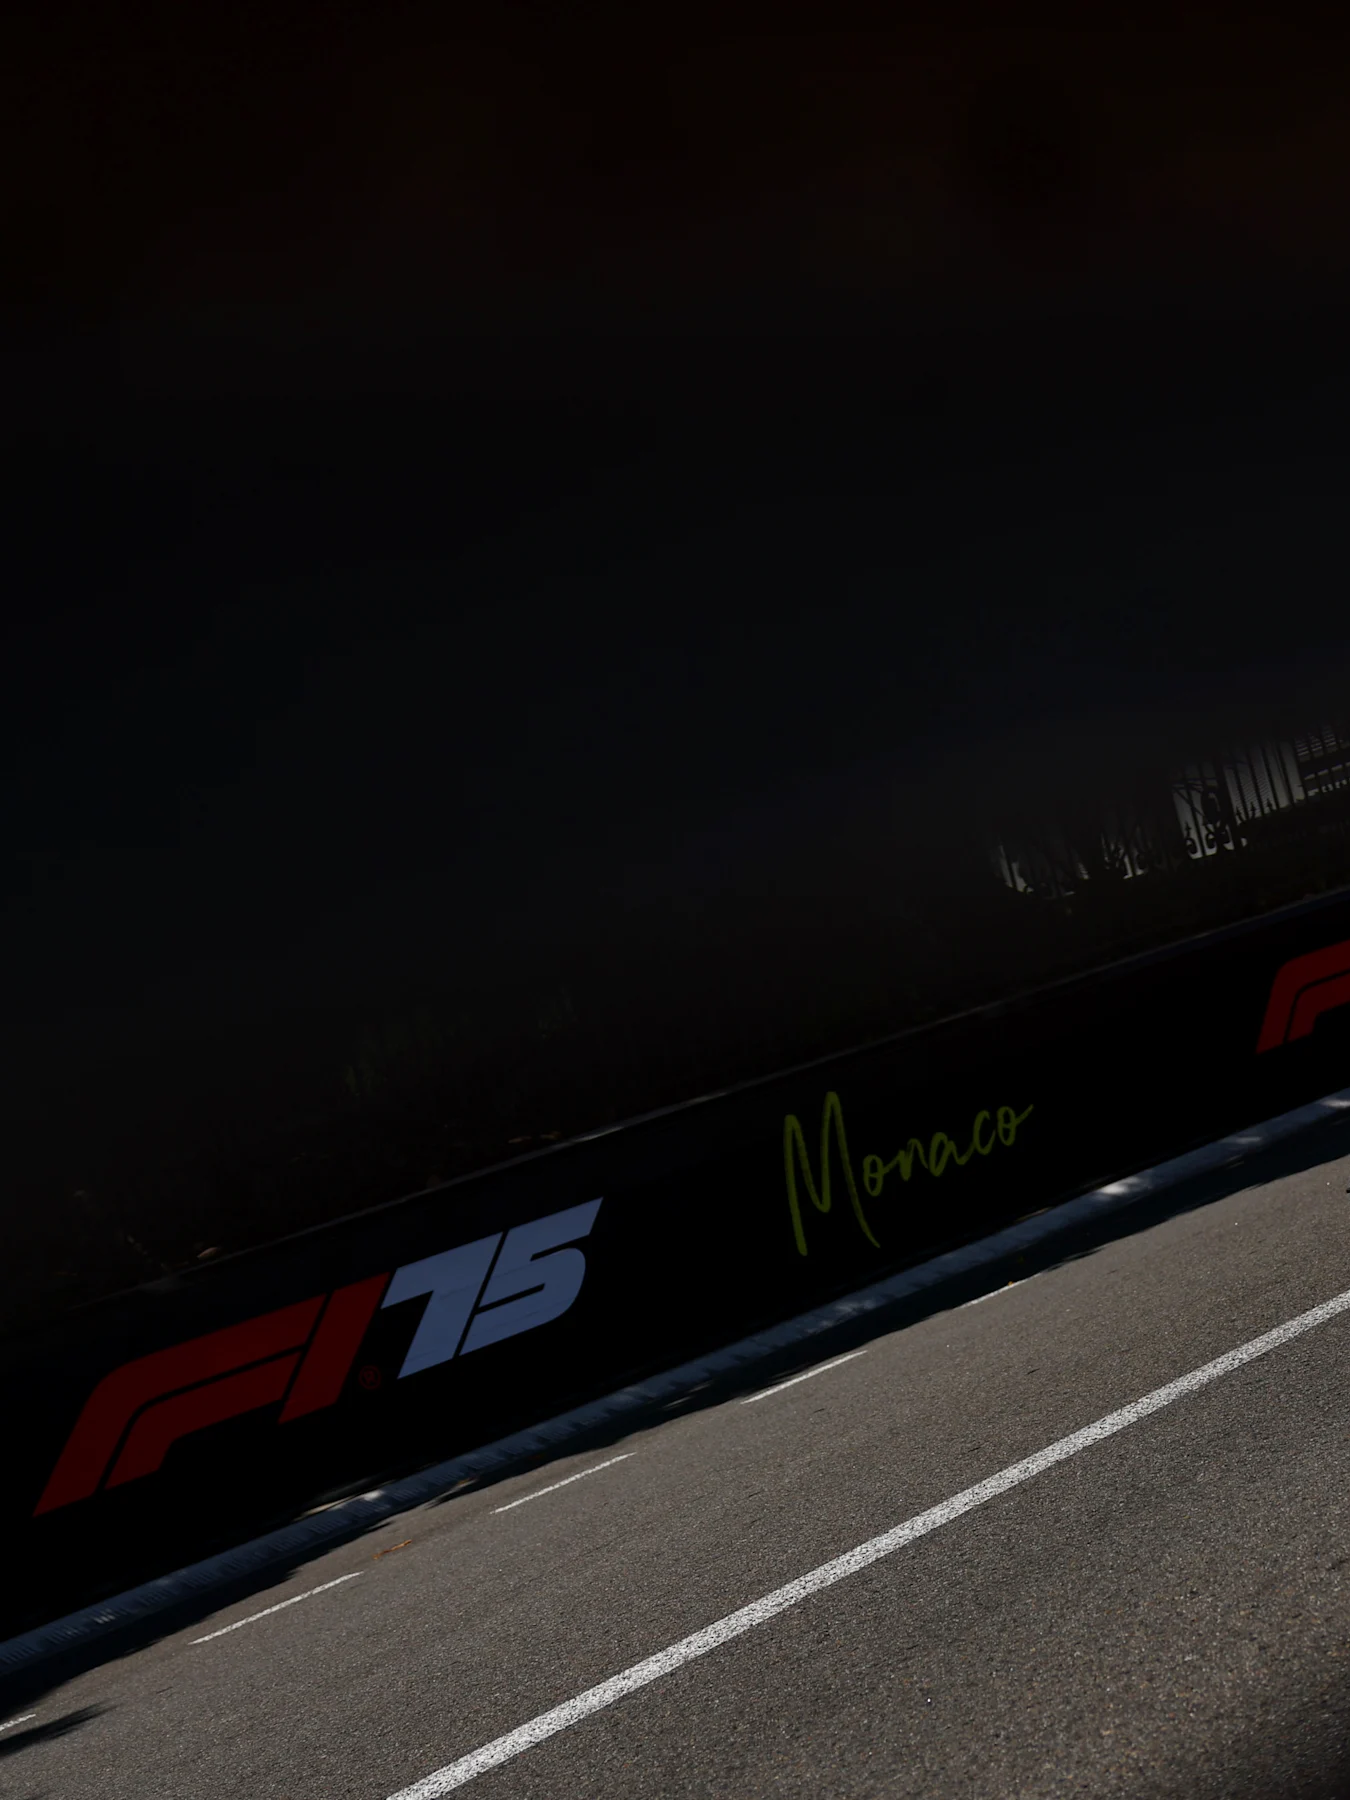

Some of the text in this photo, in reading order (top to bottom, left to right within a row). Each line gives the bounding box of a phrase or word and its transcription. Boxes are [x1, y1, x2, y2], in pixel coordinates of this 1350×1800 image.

[783, 1089, 1034, 1257] Monaco
[32, 1197, 604, 1519] F1 75
